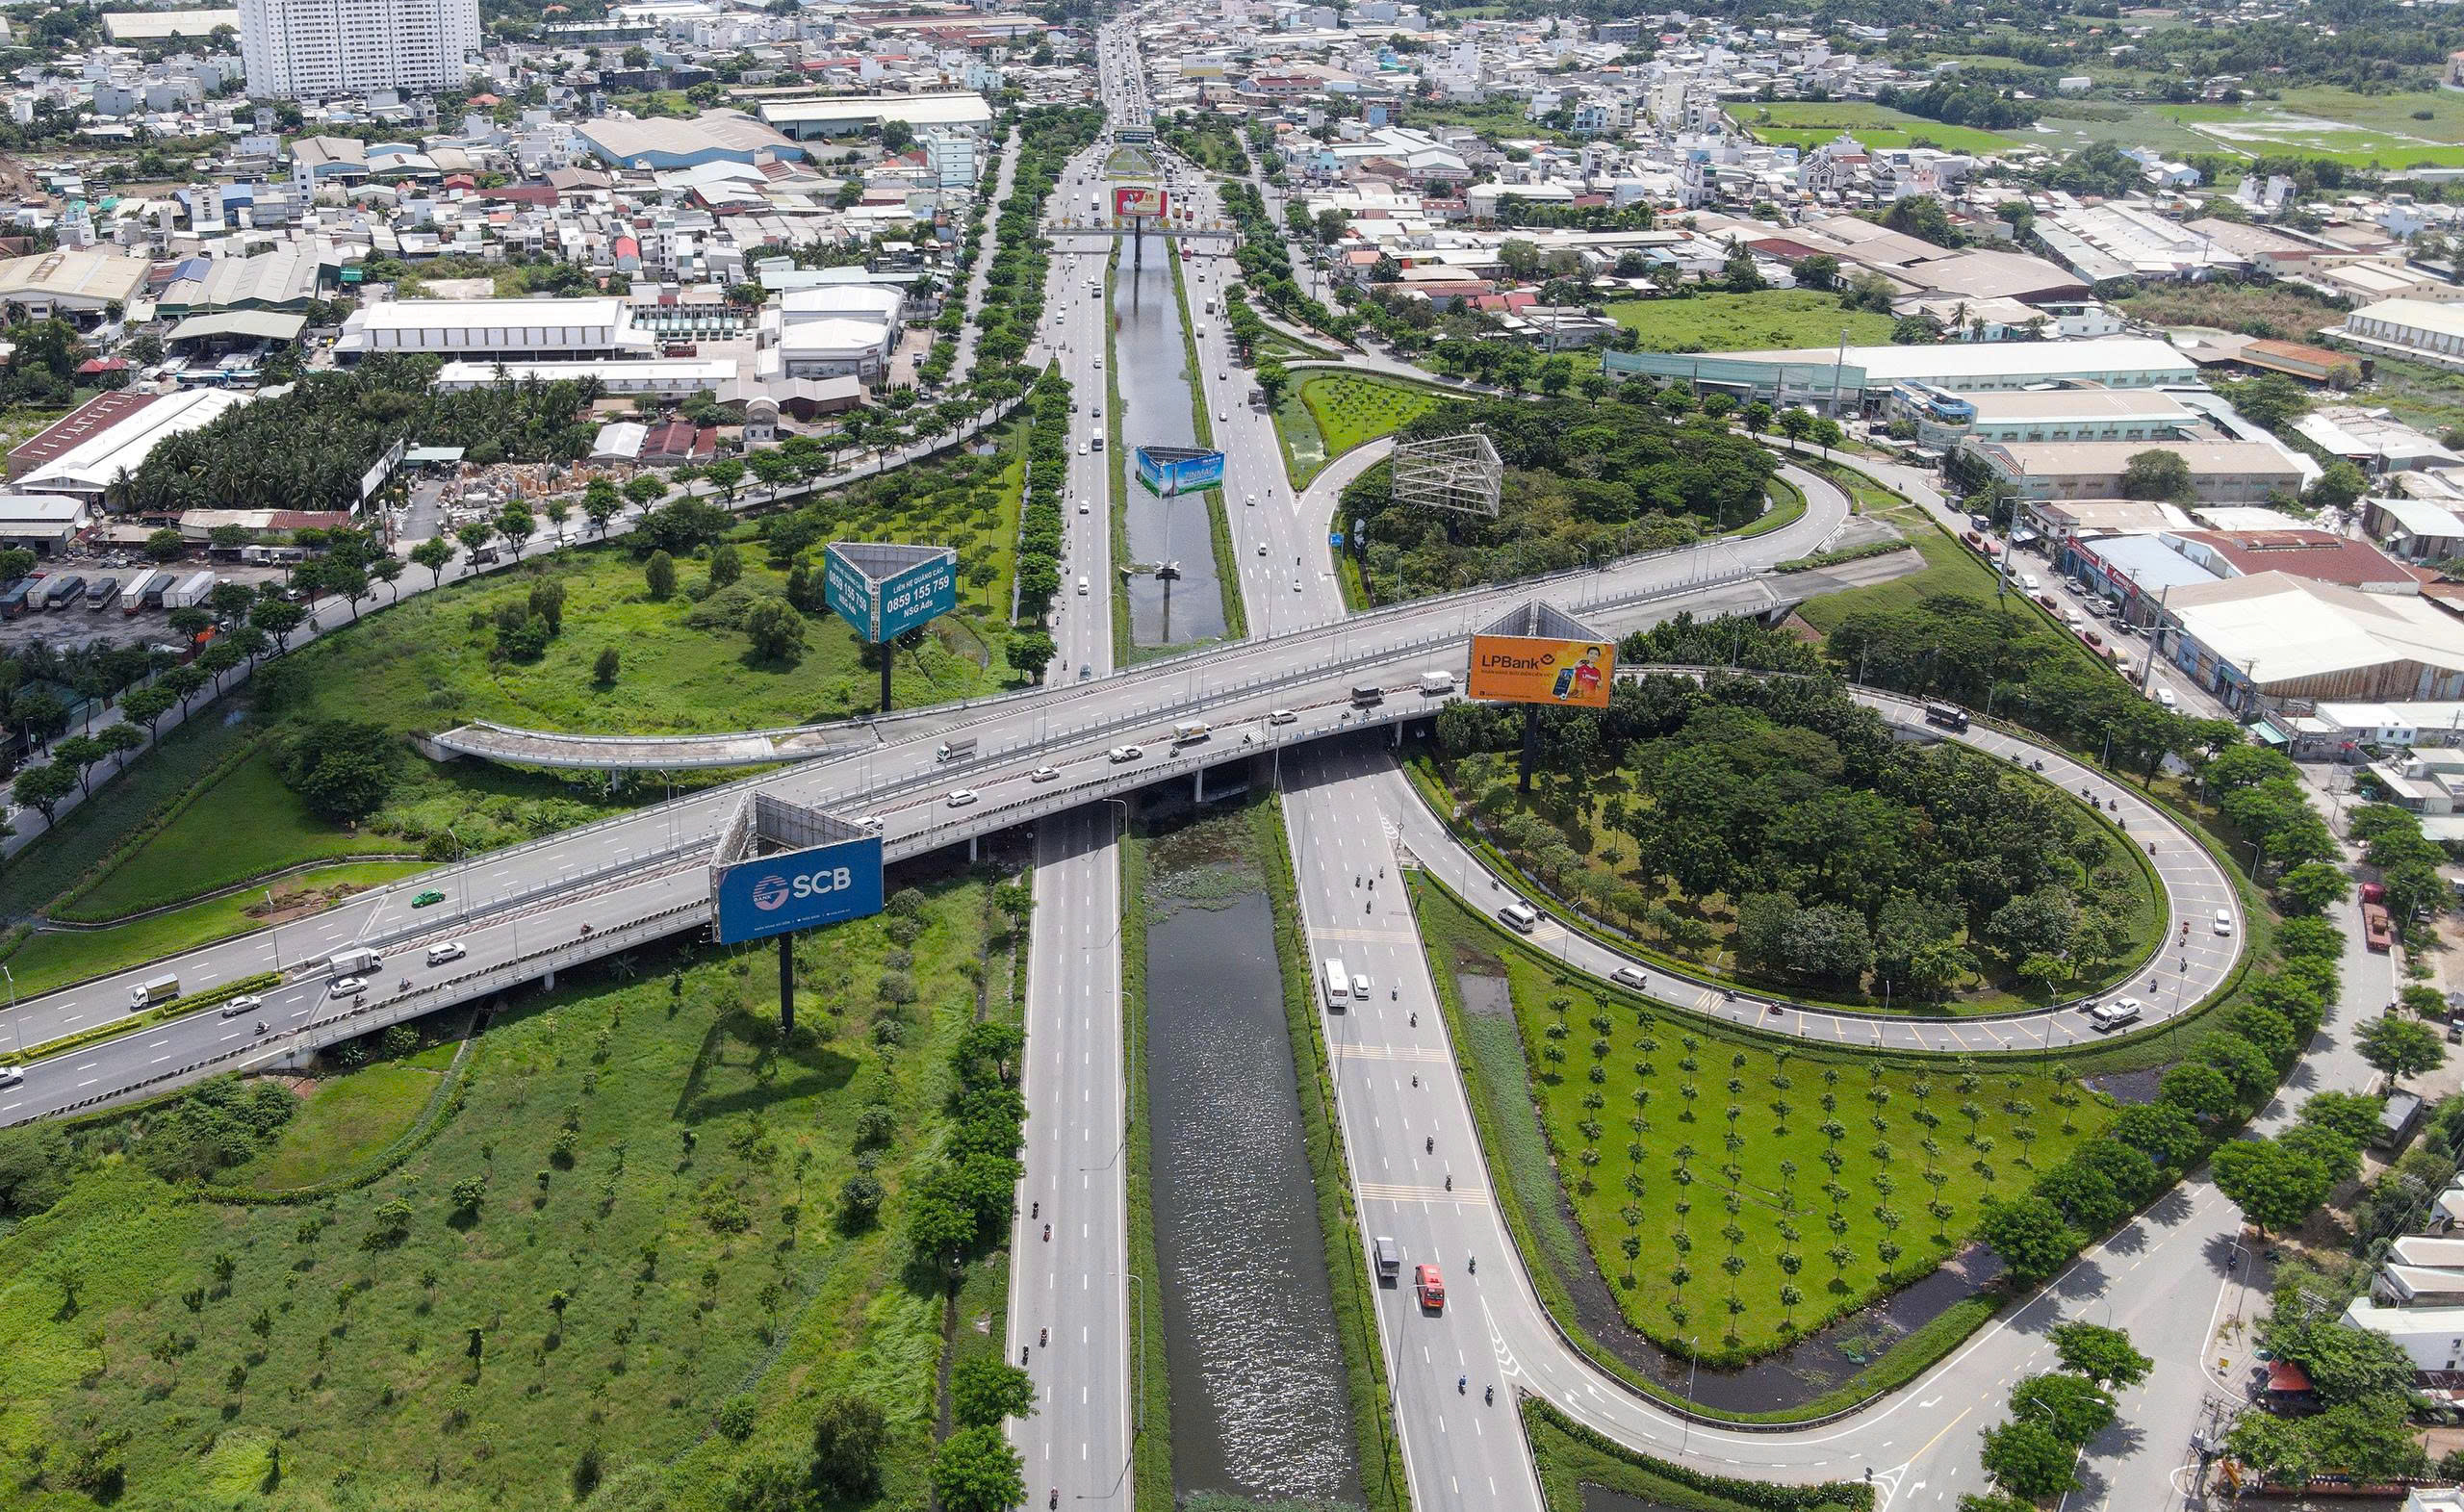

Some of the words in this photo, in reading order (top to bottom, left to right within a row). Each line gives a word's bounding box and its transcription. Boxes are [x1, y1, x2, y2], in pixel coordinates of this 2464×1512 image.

[933, 566, 944, 577] CÁO
[829, 570, 843, 591] 0859
[844, 582, 856, 602] 155
[886, 593, 911, 613] 0859
[914, 583, 931, 602] 155
[934, 576, 950, 593] 759
[904, 605, 919, 619] NSG
[920, 600, 934, 612] Ads
[1481, 654, 1539, 670] LPBank
[793, 867, 852, 899] SCB
